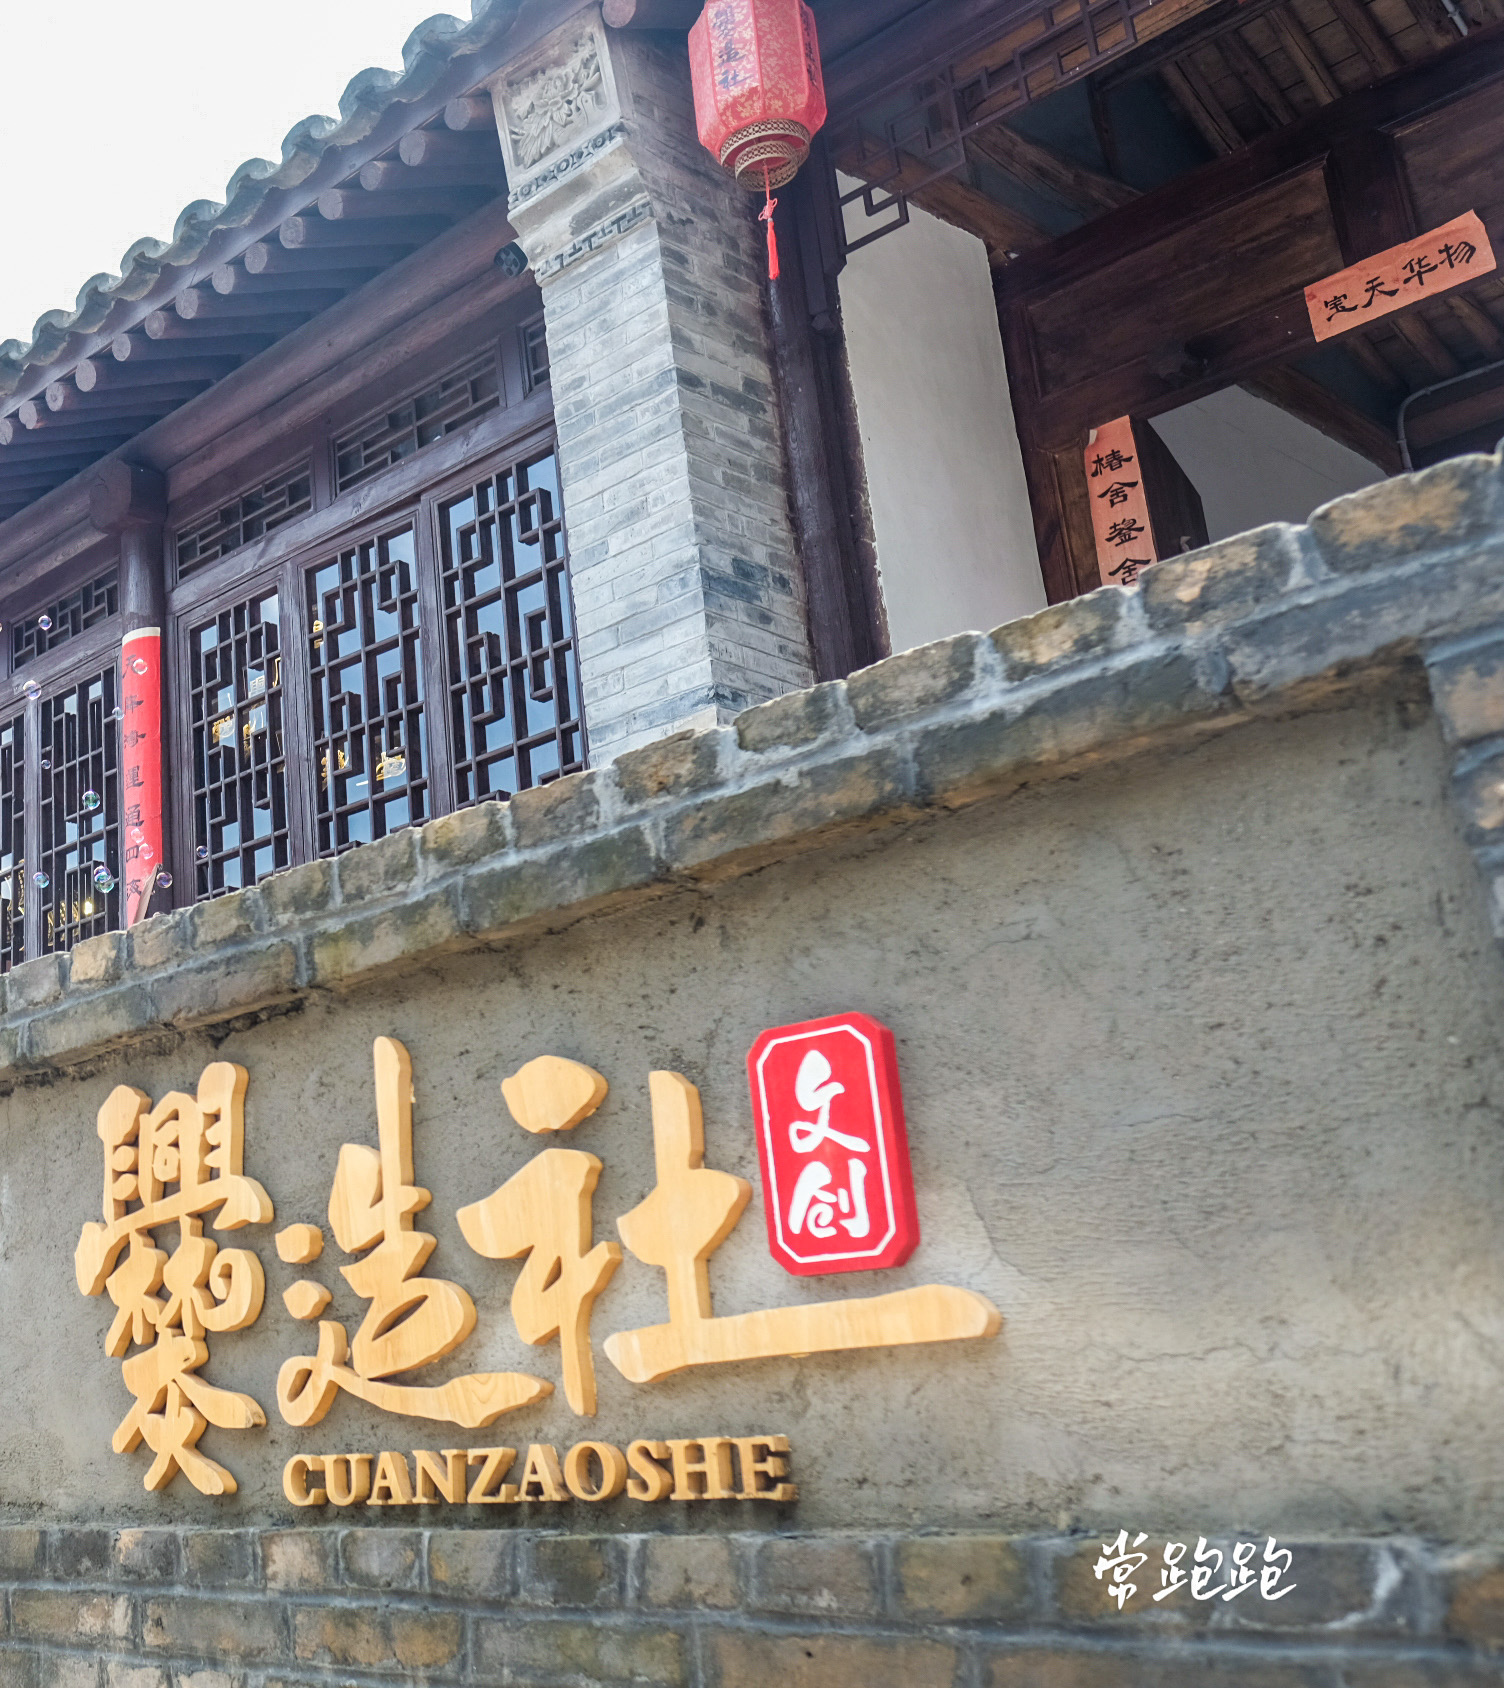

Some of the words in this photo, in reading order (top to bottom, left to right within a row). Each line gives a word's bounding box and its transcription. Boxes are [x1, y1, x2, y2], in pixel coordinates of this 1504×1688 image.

[788, 1049, 871, 1239] 文创
[75, 1036, 1002, 1495] 爨造社
[282, 1434, 799, 1507] CUANZAOSHE
